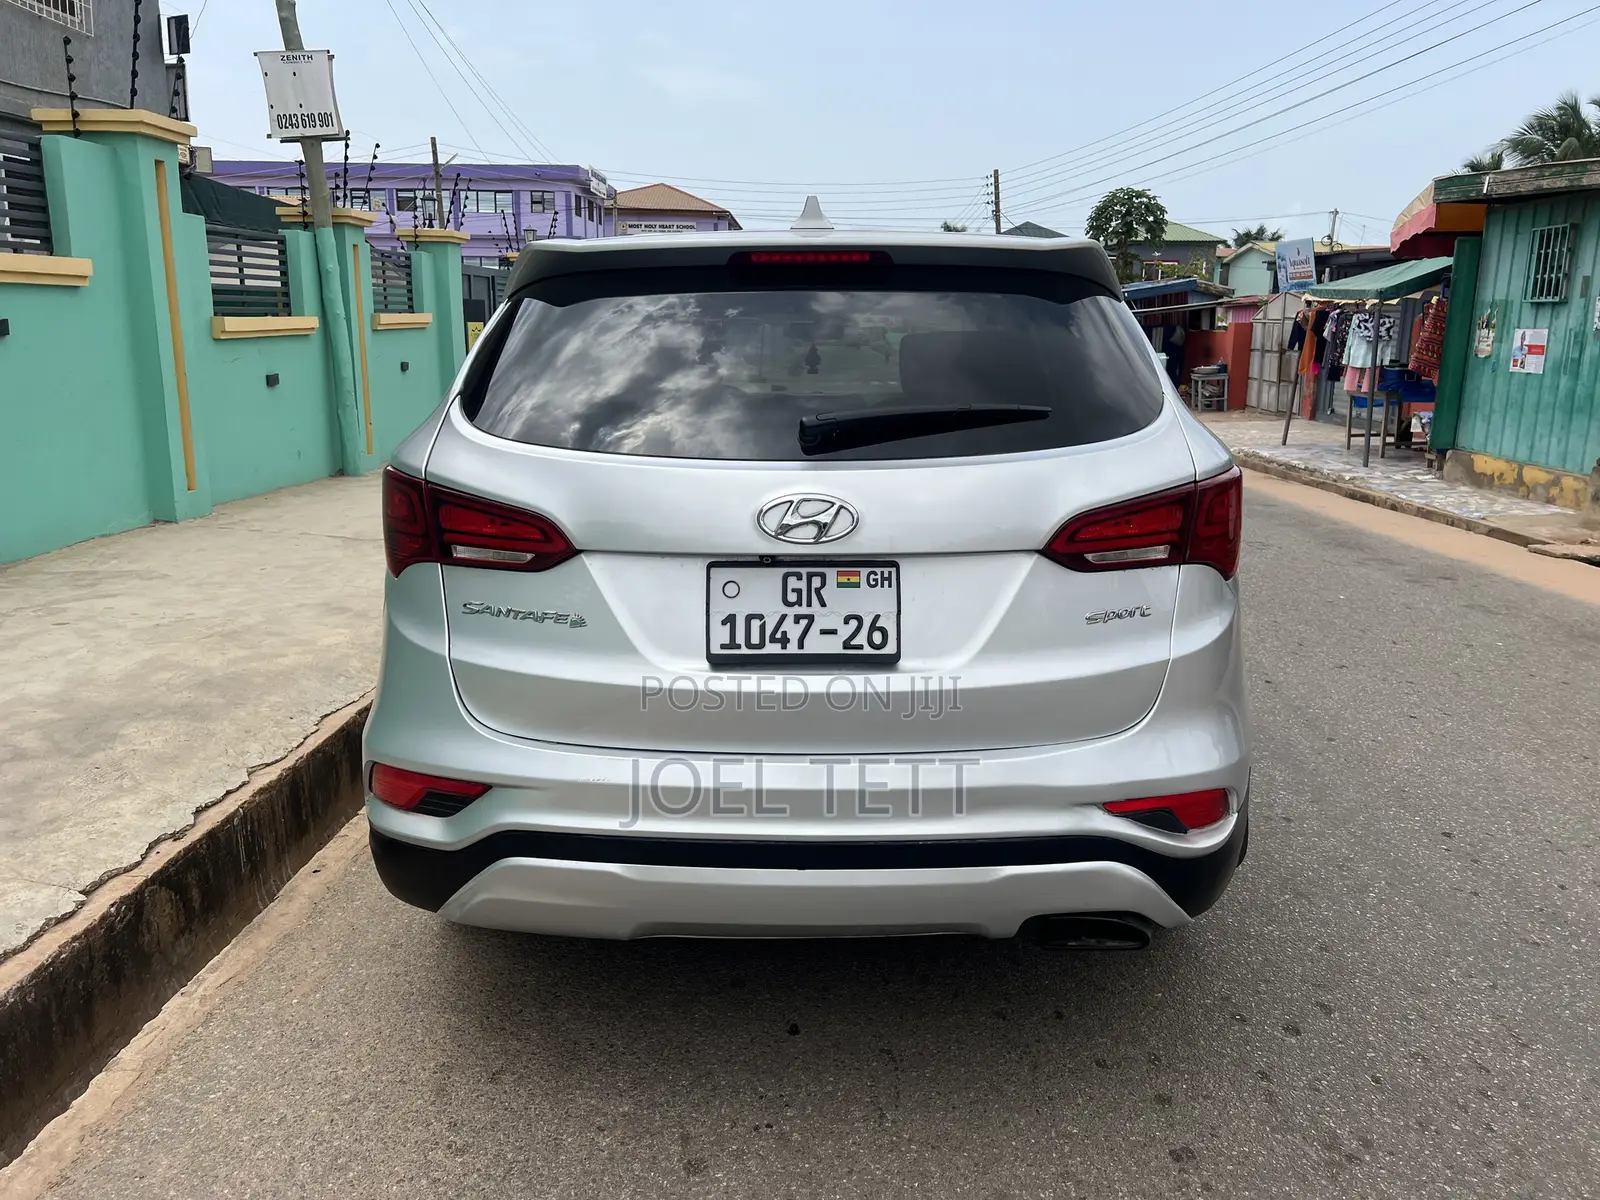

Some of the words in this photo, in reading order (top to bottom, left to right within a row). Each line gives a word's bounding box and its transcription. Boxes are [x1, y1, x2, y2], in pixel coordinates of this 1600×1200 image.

[276, 113, 299, 129] 0243
[300, 112, 317, 129] 619
[317, 112, 334, 128] 901
[781, 571, 828, 608] GR
[866, 570, 893, 589] GH
[719, 613, 890, 651] 1047-26
